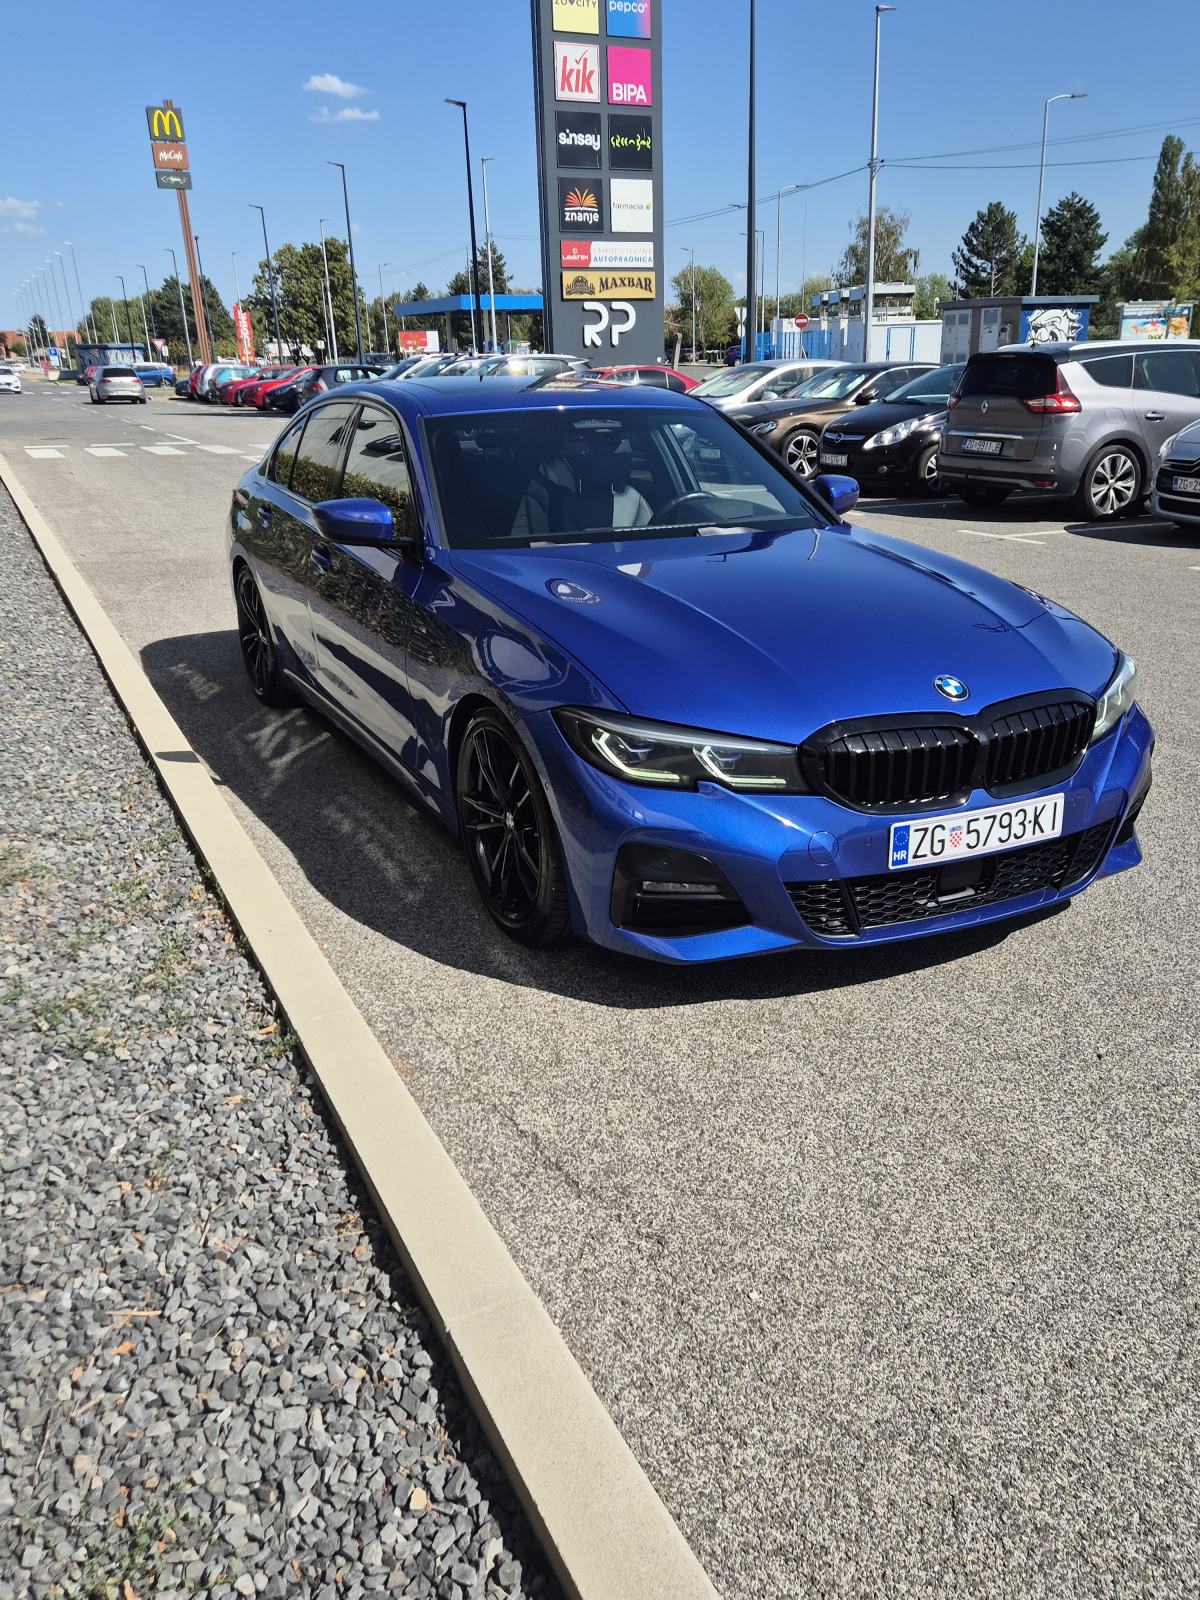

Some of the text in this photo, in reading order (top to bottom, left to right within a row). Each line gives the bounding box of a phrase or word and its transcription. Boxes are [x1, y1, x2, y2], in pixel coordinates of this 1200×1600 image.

[609, 0, 645, 13] pepco
[560, 55, 595, 94] kik
[612, 83, 647, 102] BIPA
[559, 129, 600, 150] sinsay
[612, 202, 644, 210] farmacia
[564, 211, 600, 224] znanje
[593, 255, 652, 263] AUTOPRAONICA
[599, 277, 653, 293] MAXBAR
[911, 824, 947, 860] ZG
[893, 850, 907, 861] HR
